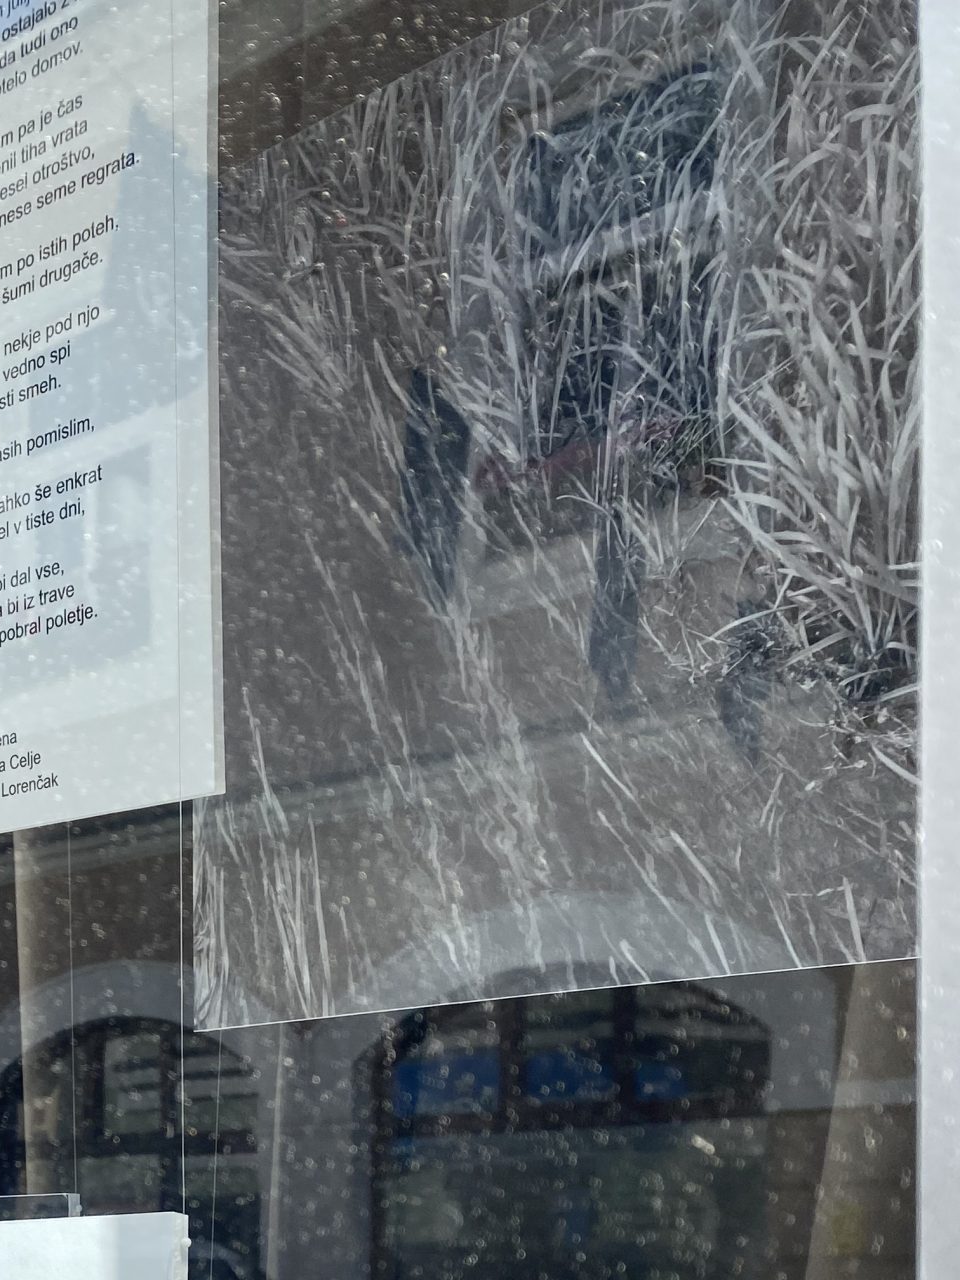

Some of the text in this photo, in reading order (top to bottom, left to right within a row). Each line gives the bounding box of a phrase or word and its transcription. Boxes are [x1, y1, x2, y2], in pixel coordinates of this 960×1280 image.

[31, 41, 83, 78] domov.
[20, 140, 46, 164] tiha
[51, 119, 88, 148] vrata
[32, 145, 95, 185] otroštvo,
[36, 180, 76, 209] seme
[81, 152, 139, 189] regrata.
[16, 253, 35, 276] po
[38, 236, 67, 261] istih
[72, 214, 119, 252] poteh,
[2, 274, 35, 304] šumi
[39, 250, 103, 288] drugače.
[3, 328, 41, 356] nekje
[45, 312, 72, 343] pod
[77, 304, 100, 328] njo
[2, 354, 45, 382] vedno
[49, 339, 70, 365] spi
[18, 373, 61, 402] smeh.
[26, 417, 94, 456] pomislim,
[13, 520, 22, 535] v
[25, 509, 54, 531] tiste
[58, 497, 85, 520] dni,
[10, 566, 31, 588] dal
[35, 562, 64, 580] vse,
[45, 603, 97, 635] poletje.
[9, 750, 41, 770] Celje
[1, 772, 59, 798] Lorenčak
